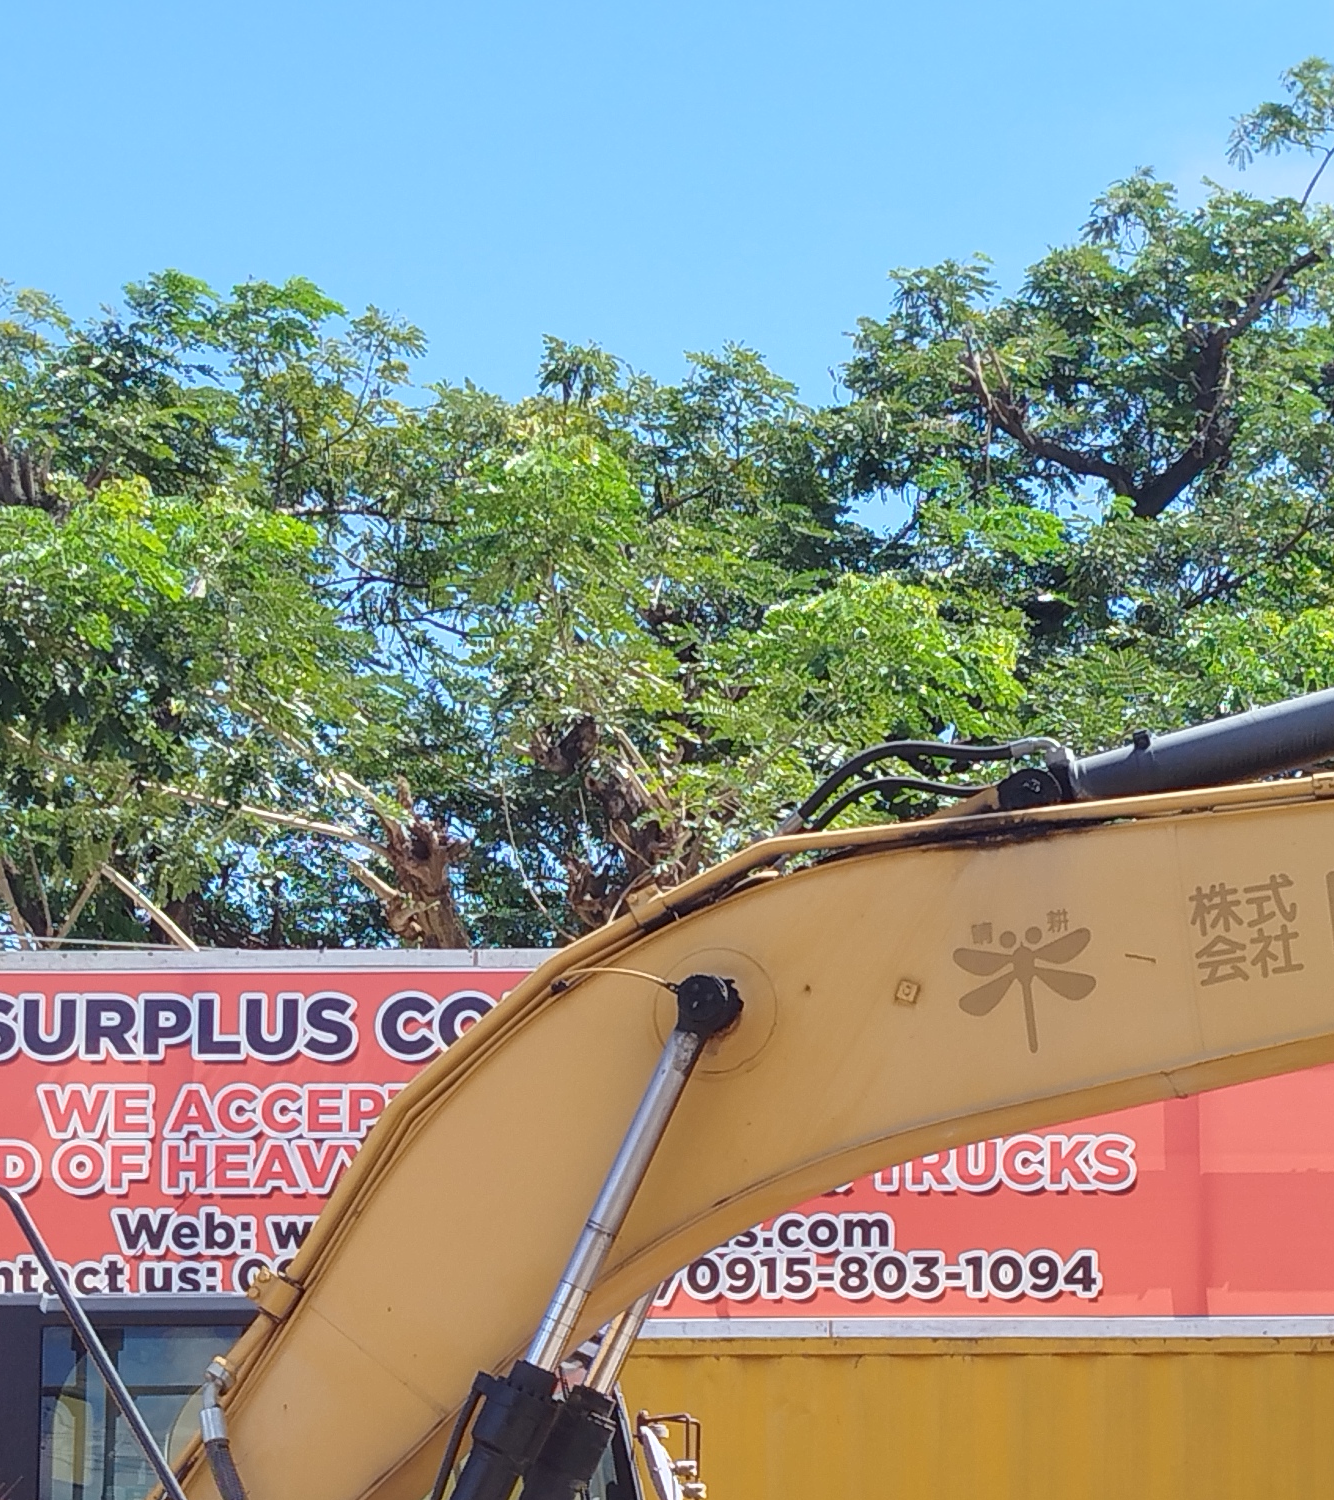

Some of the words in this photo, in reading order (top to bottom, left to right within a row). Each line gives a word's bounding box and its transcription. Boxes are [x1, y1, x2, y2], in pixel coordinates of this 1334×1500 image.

[1188, 873, 1297, 937] 株式
[1194, 924, 1305, 988] 会社
[375, 989, 515, 1061] CO
[36, 1082, 156, 1140] WE
[162, 1081, 412, 1141] ACCEP
[50, 1139, 152, 1196] OF
[110, 1205, 257, 1256] Web:
[709, 1211, 896, 1252] s.com
[140, 1257, 222, 1294] us:
